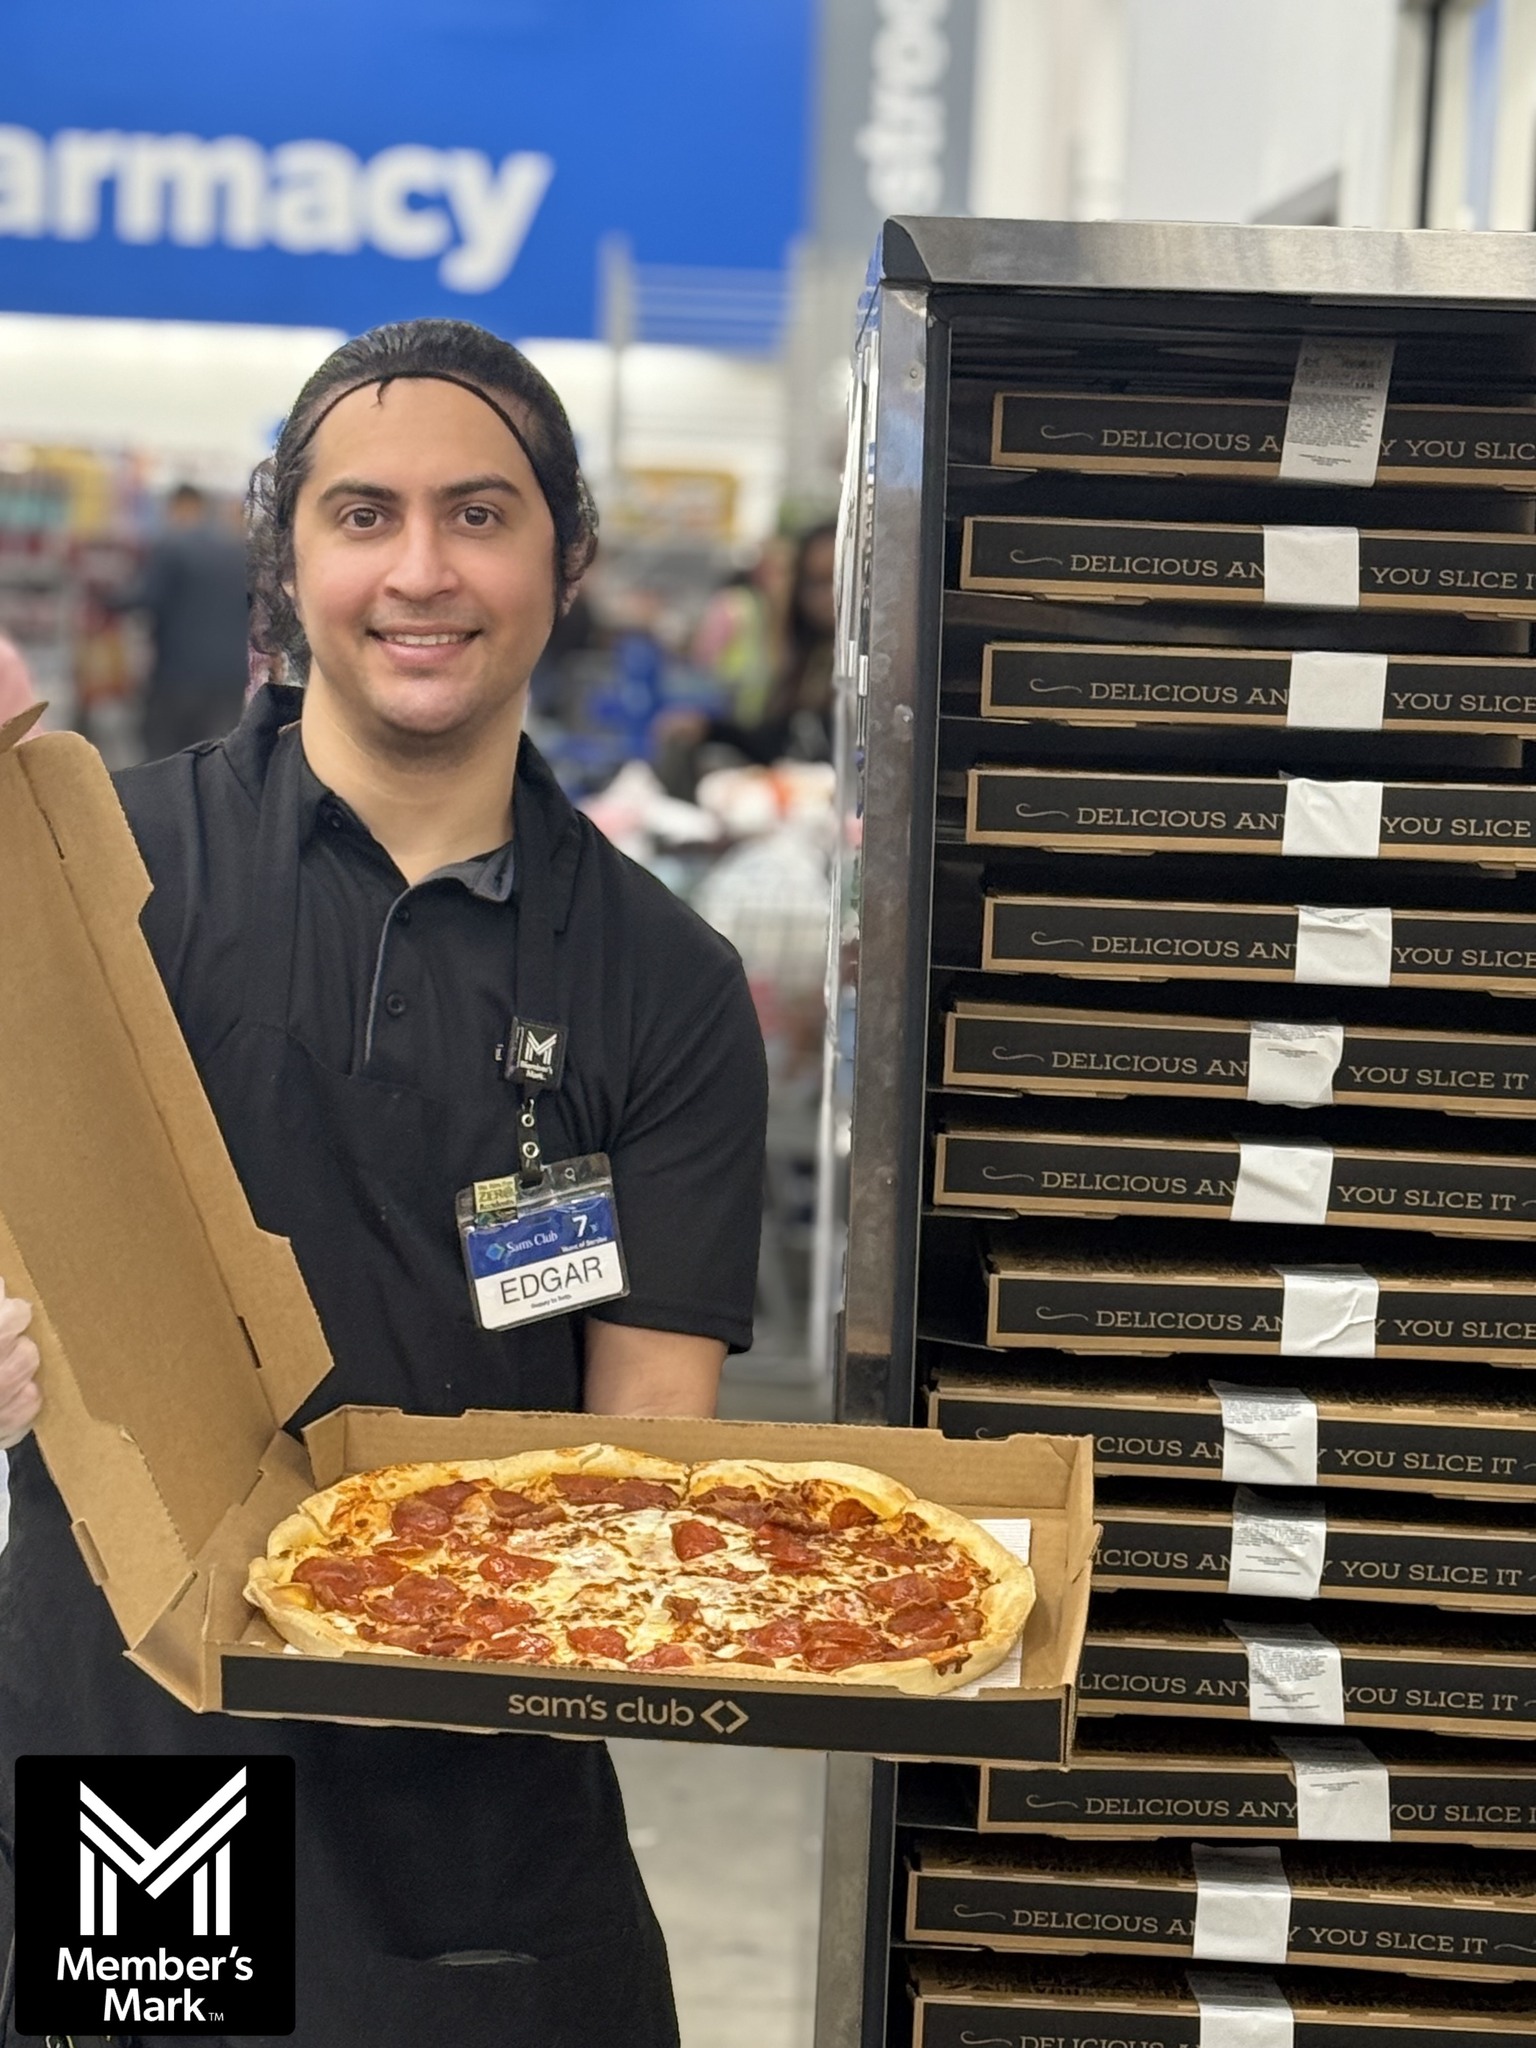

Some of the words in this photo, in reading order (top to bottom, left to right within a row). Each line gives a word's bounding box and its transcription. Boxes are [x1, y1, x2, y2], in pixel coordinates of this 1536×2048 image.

[1102, 429, 1251, 452] DELICIOUS
[1405, 440, 1466, 458] YOU
[1474, 442, 1536, 460] SLIC
[1070, 554, 1218, 577] DELICIOUS
[1225, 561, 1265, 579] AN
[1370, 566, 1431, 586] YOU
[1438, 569, 1518, 590] SLICE
[1090, 682, 1238, 704] DELICIOUS
[1245, 687, 1288, 706] AN
[1391, 692, 1453, 711] YOU
[1460, 694, 1536, 714] SLICE
[1076, 807, 1227, 829] DELICIOUS
[1233, 812, 1285, 831] AN
[1383, 816, 1443, 835] YOU
[1450, 818, 1532, 838] SLICE
[1091, 936, 1240, 958] DELICIOUS
[1246, 941, 1295, 960] AN
[1393, 946, 1454, 965] YOU
[1461, 949, 1536, 969] SLICE
[1052, 1051, 1198, 1075] DELICIOUS
[1205, 1059, 1249, 1077] AN
[1348, 1065, 1409, 1084] YOU
[1416, 1069, 1495, 1089] SLICE
[1503, 1072, 1529, 1090] IT
[1041, 1171, 1187, 1194] DELICIOUS
[1194, 1179, 1235, 1197] AN
[1336, 1185, 1397, 1205] YOU
[1404, 1189, 1483, 1210] SLICE
[1490, 1193, 1517, 1211] IT
[572, 1214, 588, 1238] 7
[500, 1256, 603, 1305] EDGAR
[1095, 1310, 1243, 1332] DELICIOUS
[1393, 1319, 1454, 1337] YOU
[1462, 1321, 1536, 1340] SLICE
[1096, 1436, 1183, 1457] CIOUS
[1334, 1448, 1396, 1468] YOU
[1403, 1452, 1483, 1473] SLICE
[1491, 1457, 1518, 1475] IT
[1094, 1549, 1189, 1569] ICIOUS
[1340, 1560, 1401, 1580] YOU
[1408, 1564, 1488, 1585] SLICE
[1496, 1568, 1523, 1586] IT
[1079, 1673, 1186, 1694] LICIOUS
[1344, 1686, 1398, 1705] YOU
[1405, 1689, 1484, 1710] SLICE
[1492, 1694, 1519, 1711] IT
[508, 1694, 608, 1721] sam's
[616, 1697, 695, 1727] club
[1086, 1798, 1230, 1817] DELICIOUS
[1236, 1801, 1297, 1819] ANY
[1444, 1805, 1521, 1823] SLICE
[1013, 1910, 1158, 1933] DELICIOUS
[1308, 1927, 1368, 1946] YOU
[1376, 1931, 1454, 1953] SLICE
[1462, 1937, 1488, 1954] IT
